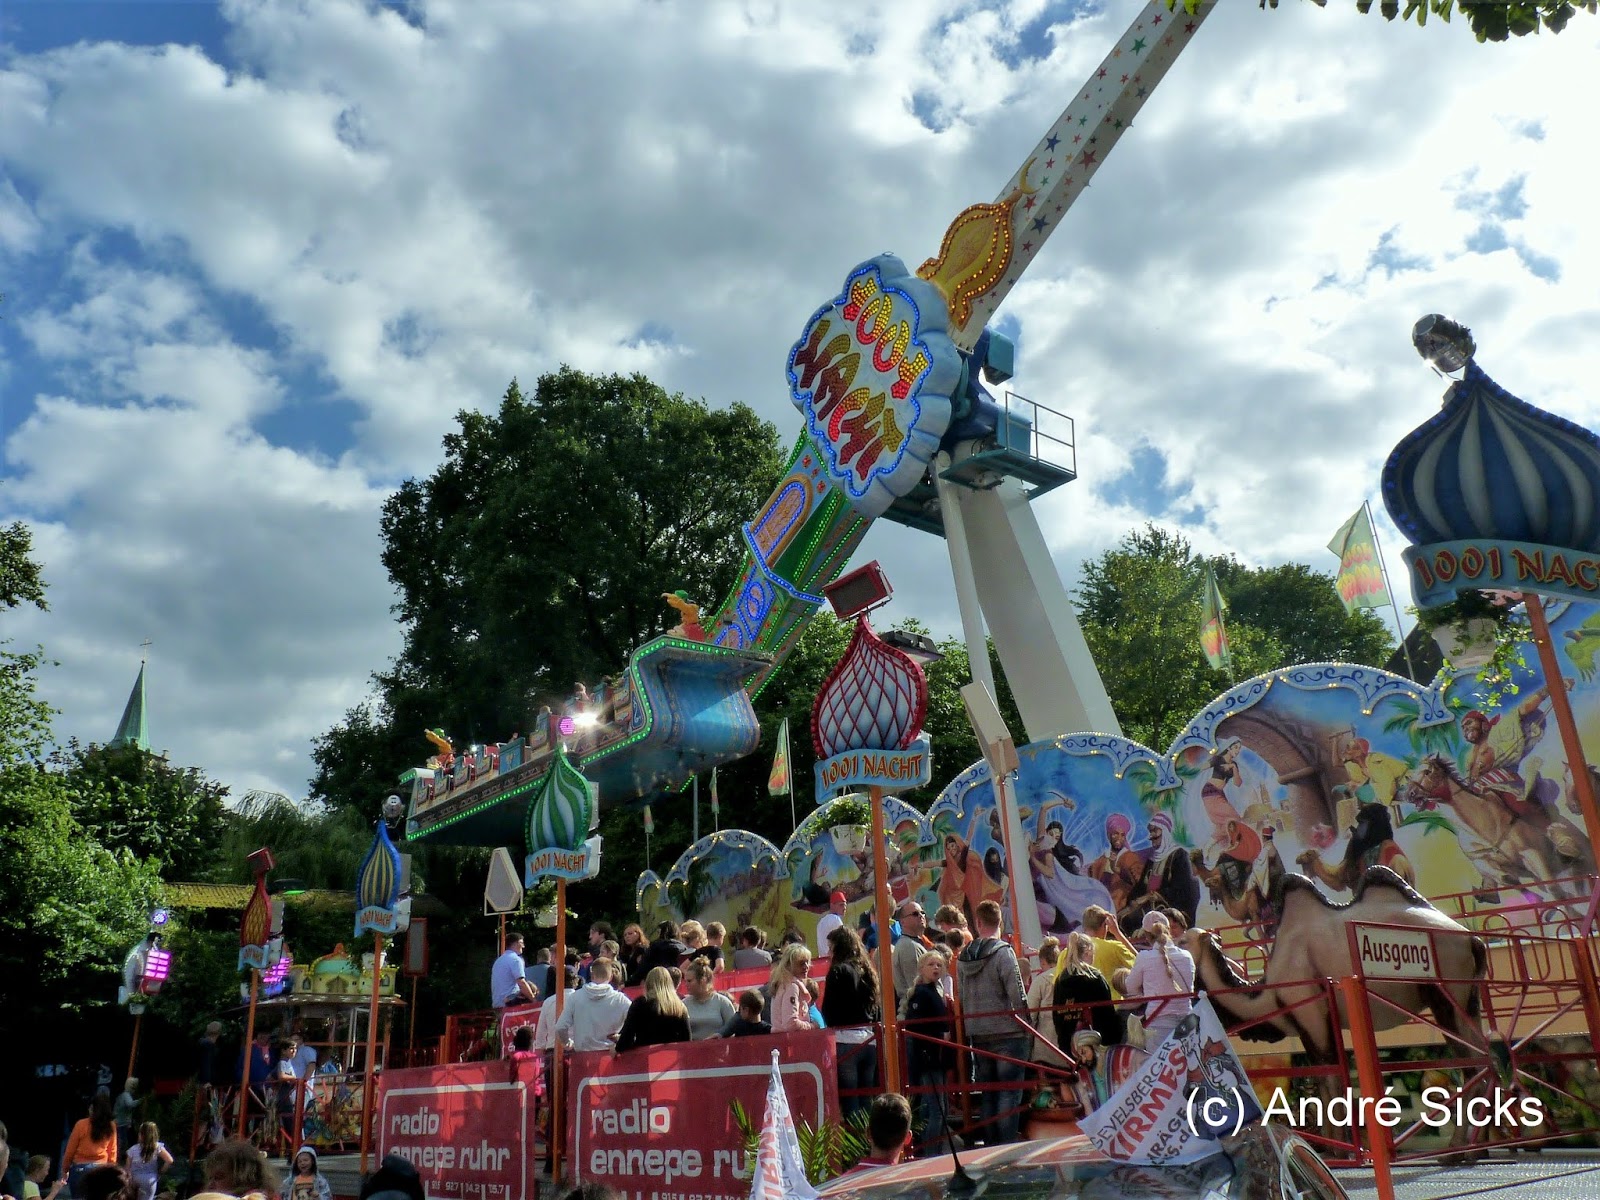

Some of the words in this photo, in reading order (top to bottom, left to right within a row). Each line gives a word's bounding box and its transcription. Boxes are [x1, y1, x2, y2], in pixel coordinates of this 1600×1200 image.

[843, 277, 929, 399] 1001
[795, 319, 904, 481] NACHT
[1414, 546, 1502, 590] 1001
[1511, 547, 1600, 591] NAC
[822, 754, 858, 790] 1001
[862, 753, 923, 779] NACHT
[553, 852, 586, 873] NACHT
[1362, 935, 1430, 971] Ausgang
[1089, 1041, 1176, 1149] GEVELSBERGER
[1101, 1047, 1188, 1161] KIRMES
[391, 1106, 440, 1135] radio
[591, 1098, 671, 1135] radio
[459, 1139, 510, 1171] ruhr
[590, 1149, 702, 1185] ennepe
[713, 1149, 750, 1179] ru
